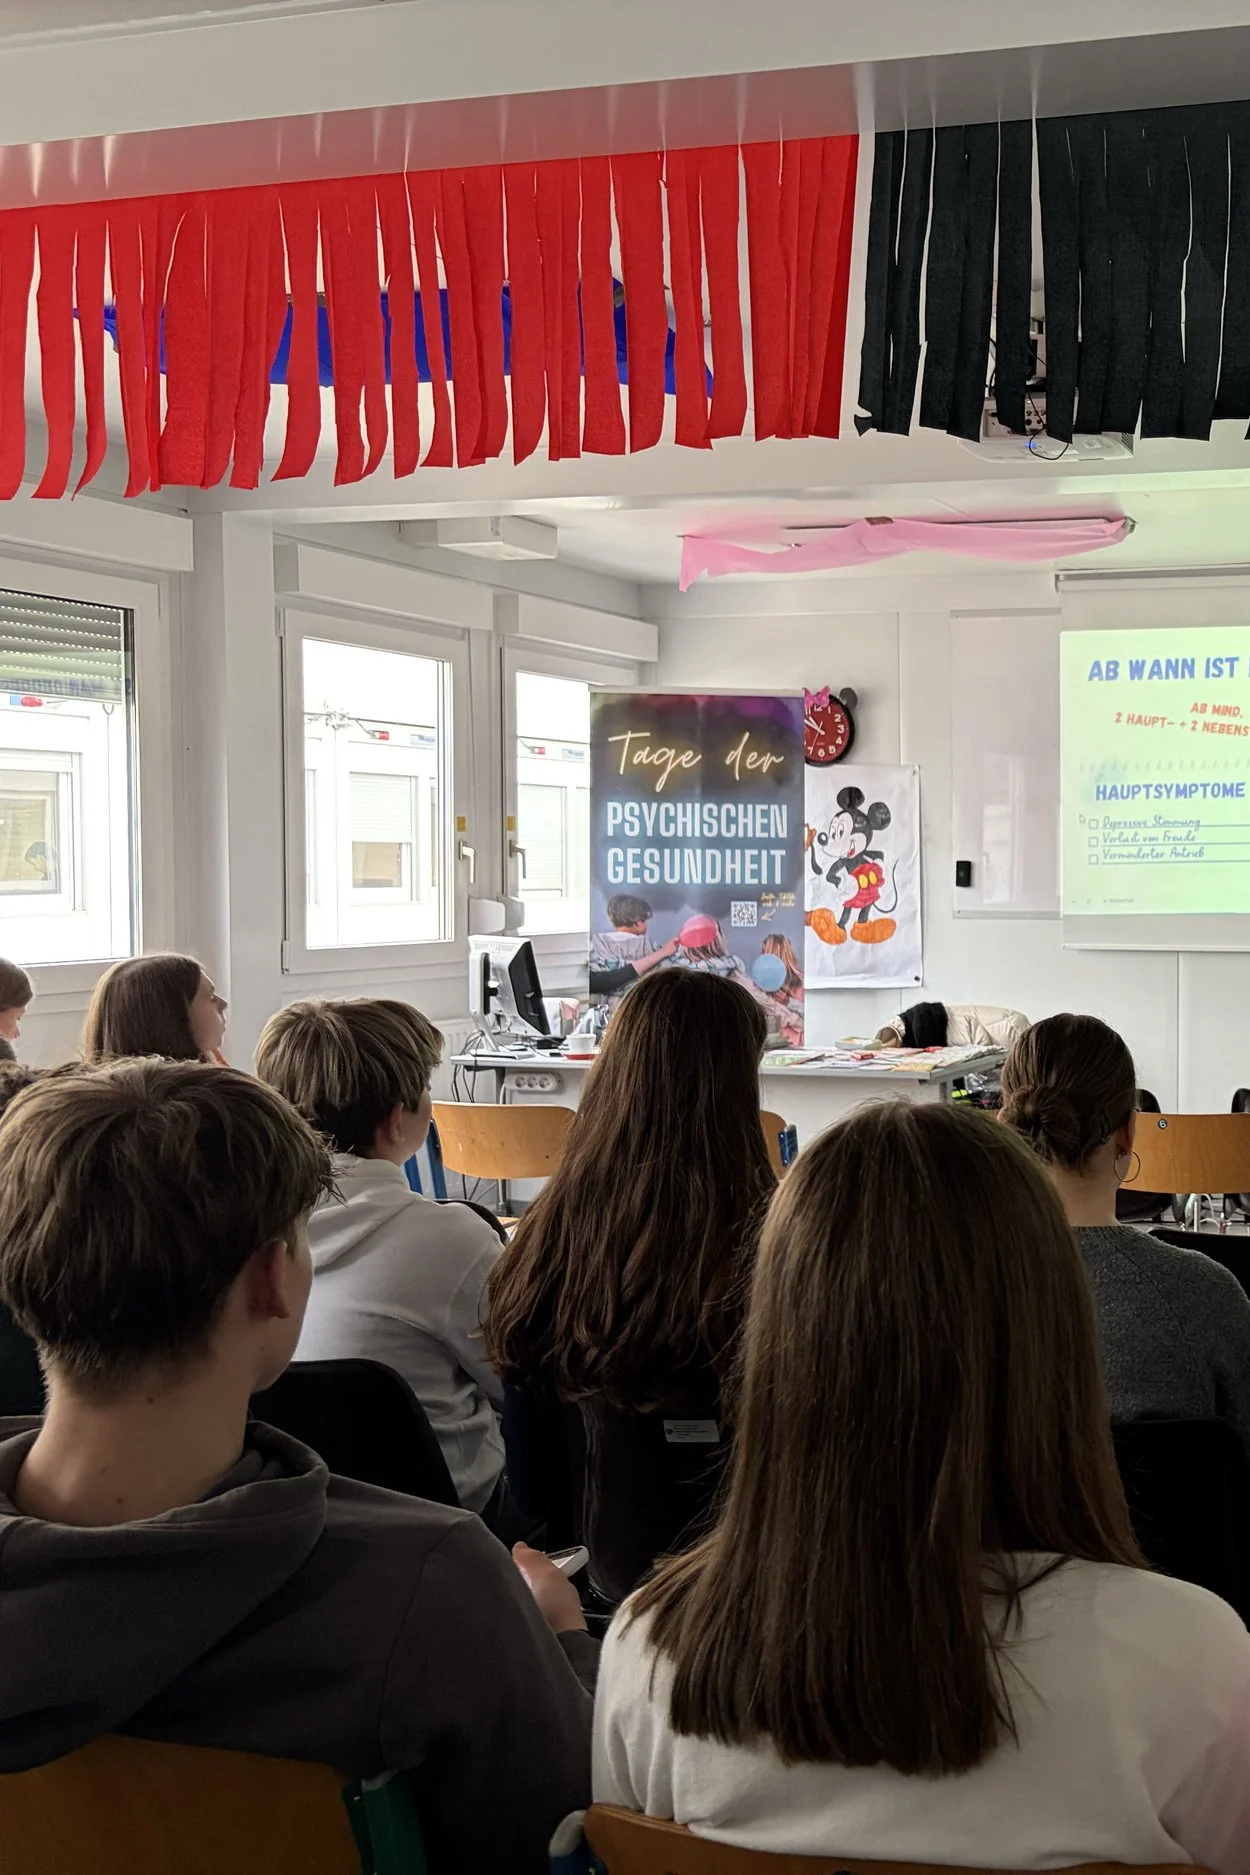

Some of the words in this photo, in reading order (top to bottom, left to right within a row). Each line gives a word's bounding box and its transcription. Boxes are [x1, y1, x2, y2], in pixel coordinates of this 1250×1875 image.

[1088, 660, 1120, 681] AB
[1128, 658, 1195, 680] WANN
[1205, 656, 1239, 679] IST
[834, 713, 841, 723] 2
[1190, 702, 1208, 714] AB
[1211, 704, 1244, 718] MIND.
[837, 724, 845, 734] 3
[1114, 712, 1122, 724] 2
[1126, 713, 1175, 728] HAUPT-
[1190, 720, 1198, 732] 2
[836, 736, 843, 745] 4
[818, 748, 825, 758] 6
[828, 745, 836, 755] 5
[608, 731, 702, 792] Tage
[725, 732, 784, 781] der
[1095, 781, 1247, 801] HAUPTSYMPTOME
[606, 801, 788, 839] PSYCHISCHEN
[1102, 815, 1148, 833] Depressive
[1152, 814, 1201, 832] Stimmung
[1102, 831, 1141, 844] Verlust
[1162, 830, 1196, 843] Freude
[1102, 849, 1165, 861] Verminderter
[1169, 846, 1205, 860] Antrieb
[606, 848, 786, 885] GESUNDHEIT
